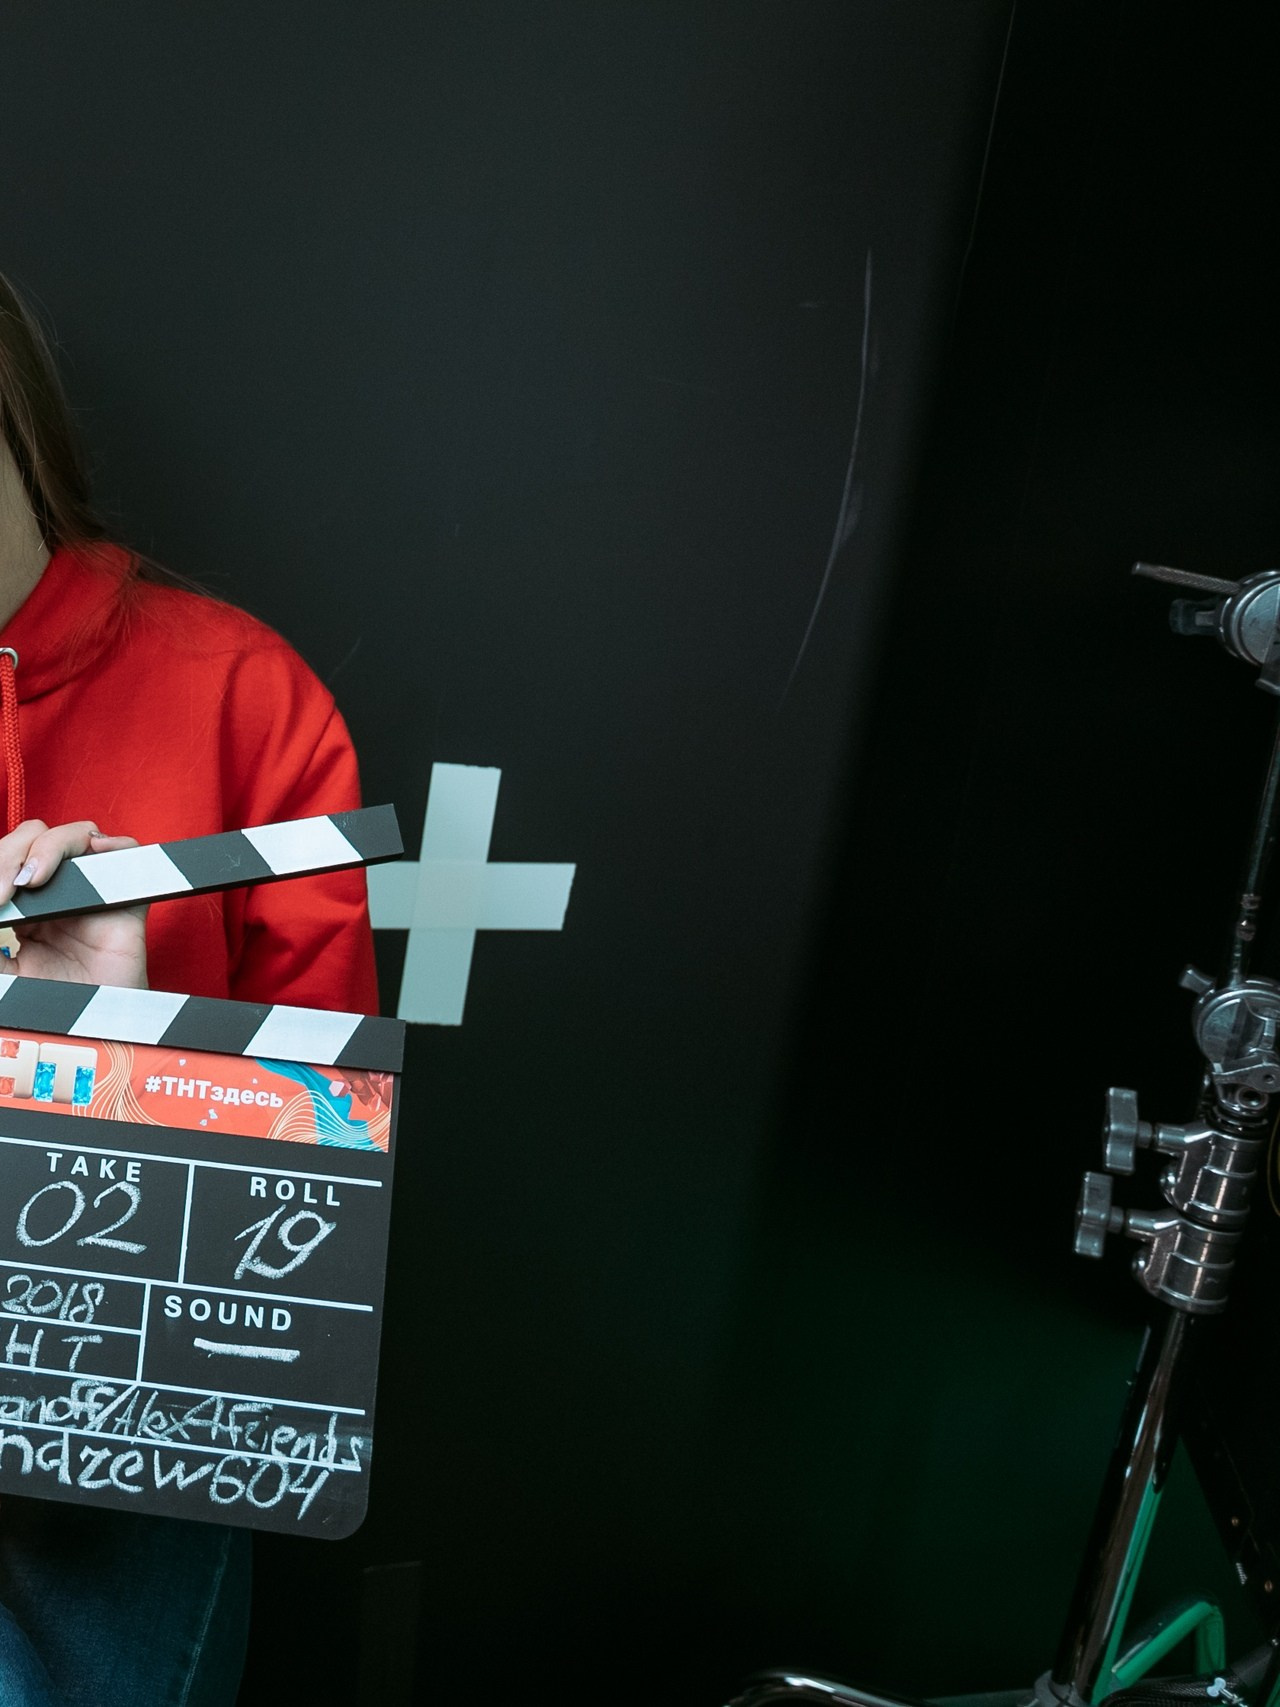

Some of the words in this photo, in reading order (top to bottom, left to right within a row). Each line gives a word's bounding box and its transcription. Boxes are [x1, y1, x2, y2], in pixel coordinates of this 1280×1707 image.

[145, 1074, 284, 1108] #ТНТздесь
[46, 1151, 142, 1184] TAKE
[249, 1175, 341, 1207] ROLL
[16, 1180, 148, 1254] 02
[233, 1203, 337, 1280] 19
[164, 1294, 293, 1332] SOUND
